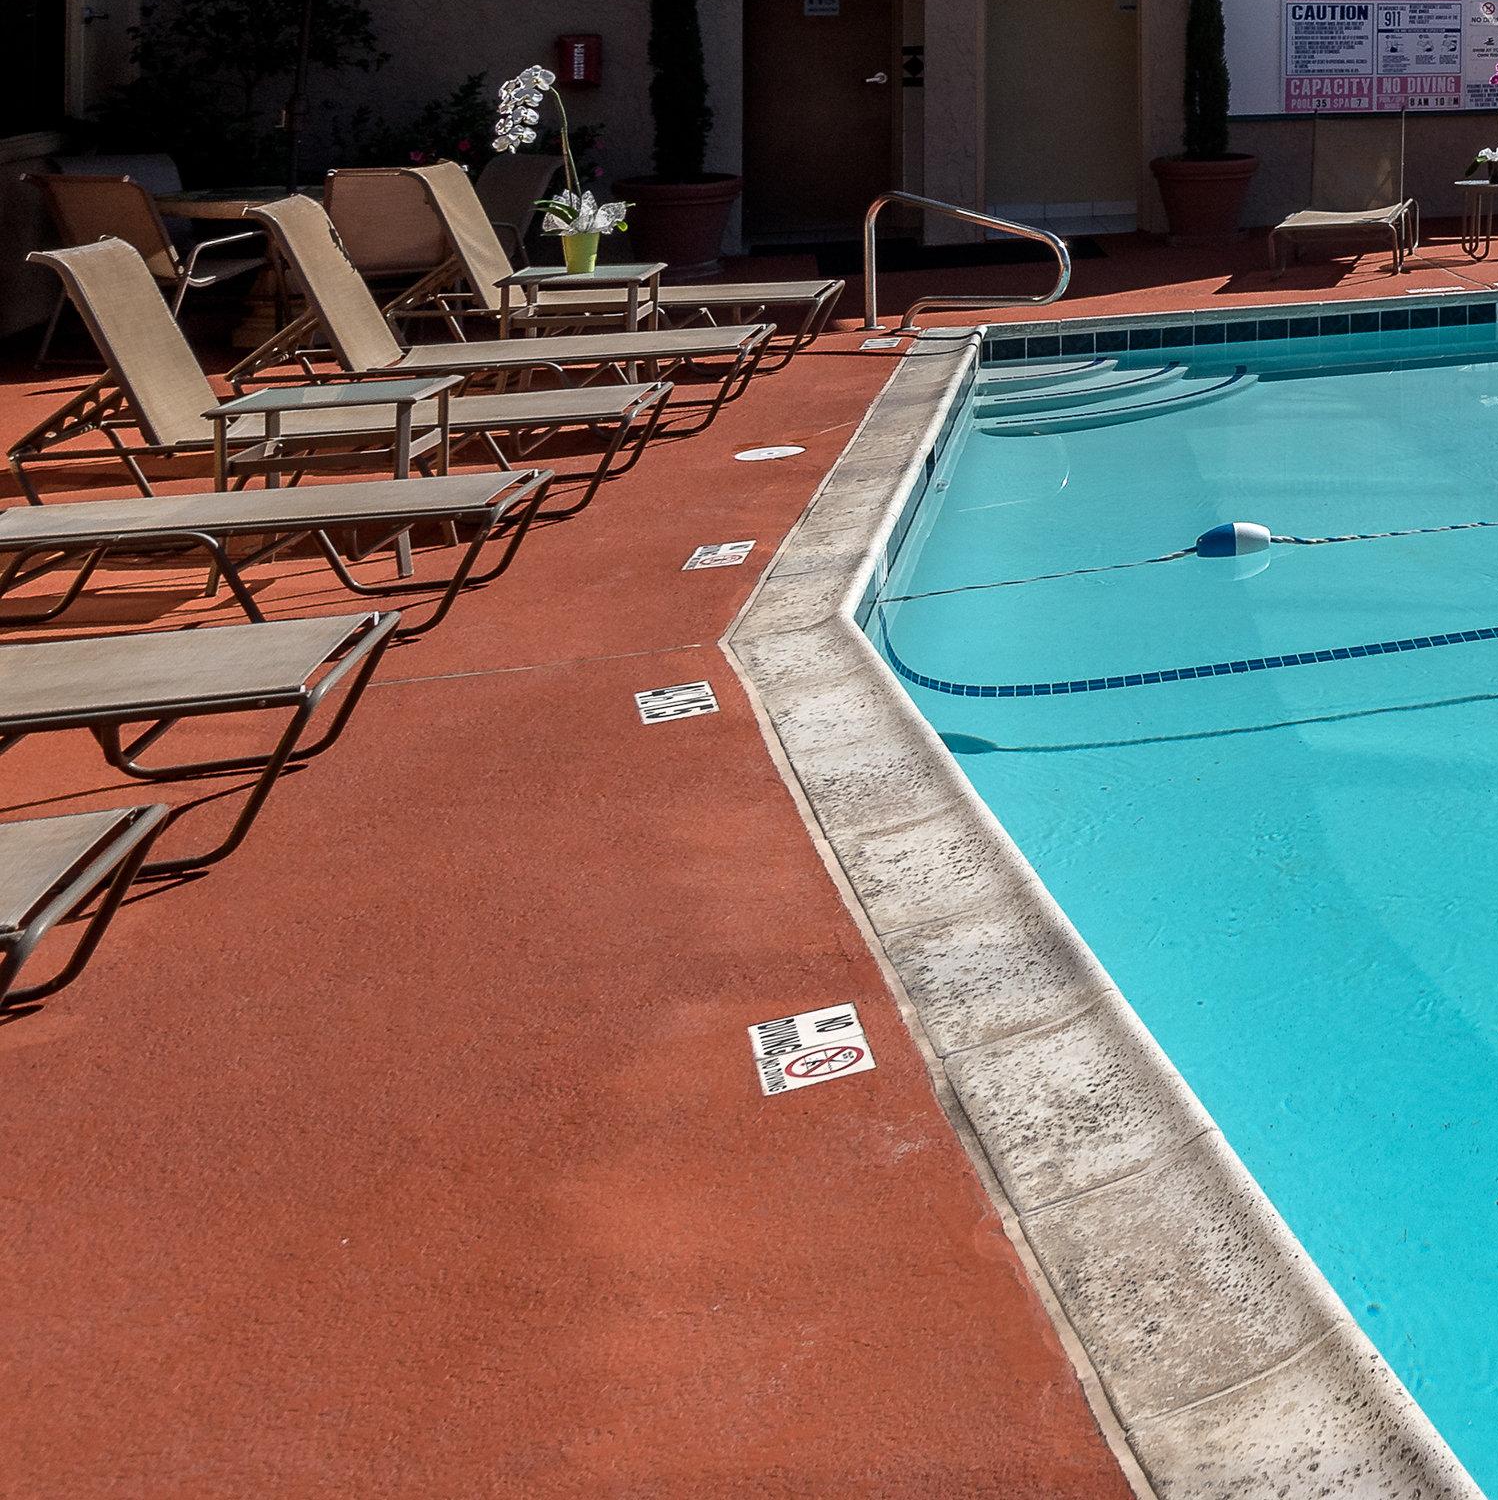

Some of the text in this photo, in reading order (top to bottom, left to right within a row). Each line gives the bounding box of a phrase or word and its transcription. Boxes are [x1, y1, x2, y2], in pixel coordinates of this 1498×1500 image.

[1292, 5, 1369, 21] CAUTION
[1384, 11, 1401, 27] 911
[1290, 78, 1371, 96] CAPACITY
[1382, 76, 1455, 94] NO DIVING
[1291, 98, 1312, 109] POOL
[1315, 99, 1328, 108] 35
[1356, 98, 1363, 108] 7
[1417, 97, 1430, 106] AM
[814, 1013, 855, 1033] NO
[757, 1017, 803, 1056] DIVING
[760, 1057, 788, 1093] NO DIVING
